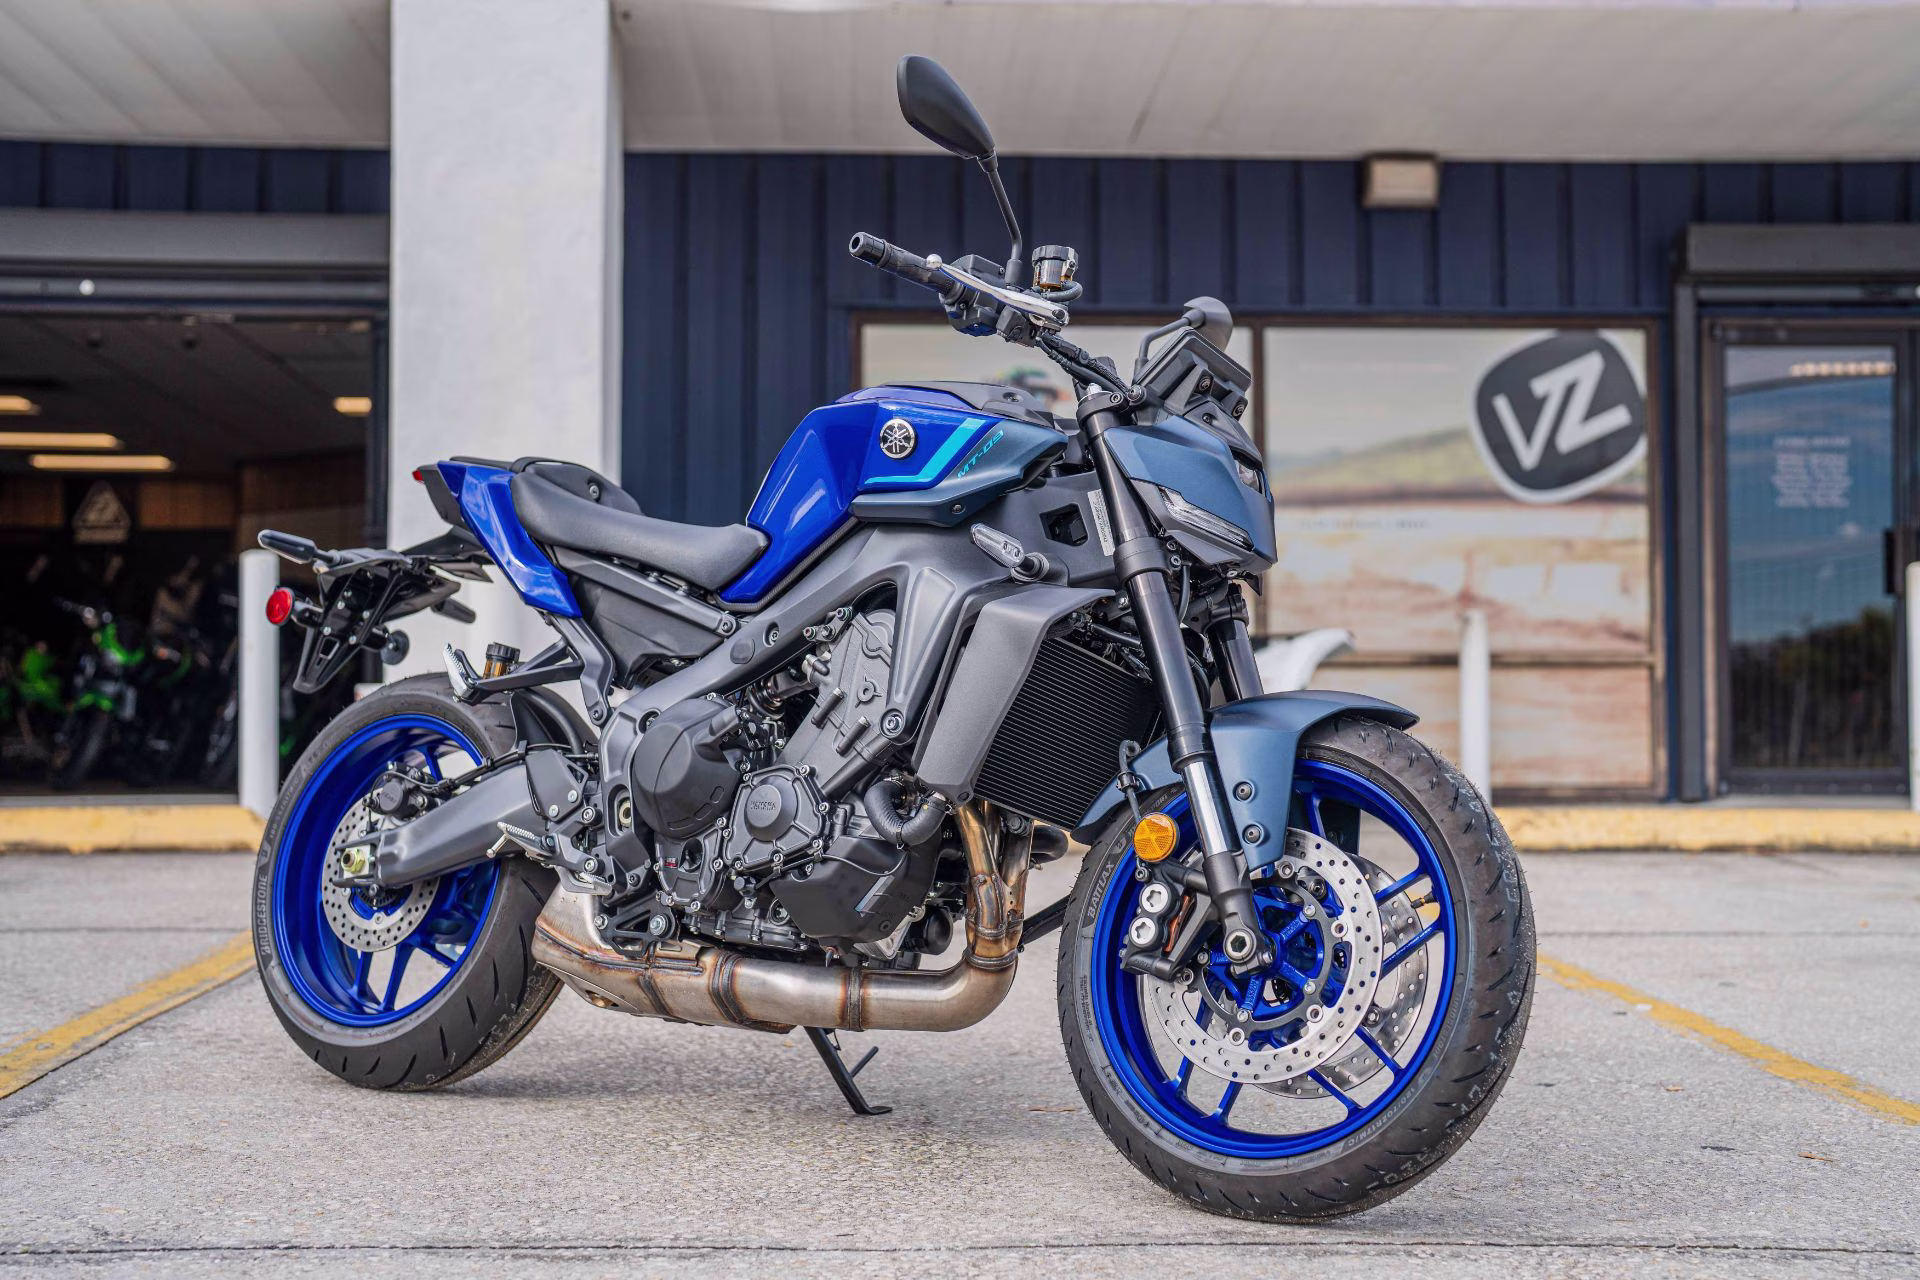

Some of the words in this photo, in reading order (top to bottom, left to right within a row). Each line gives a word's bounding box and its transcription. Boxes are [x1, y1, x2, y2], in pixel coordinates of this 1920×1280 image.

[1492, 350, 1632, 471] VZ
[957, 429, 1004, 479] MT-09
[257, 874, 271, 956] BRIDGESTONE
[1087, 860, 1114, 919] BATTLAX
